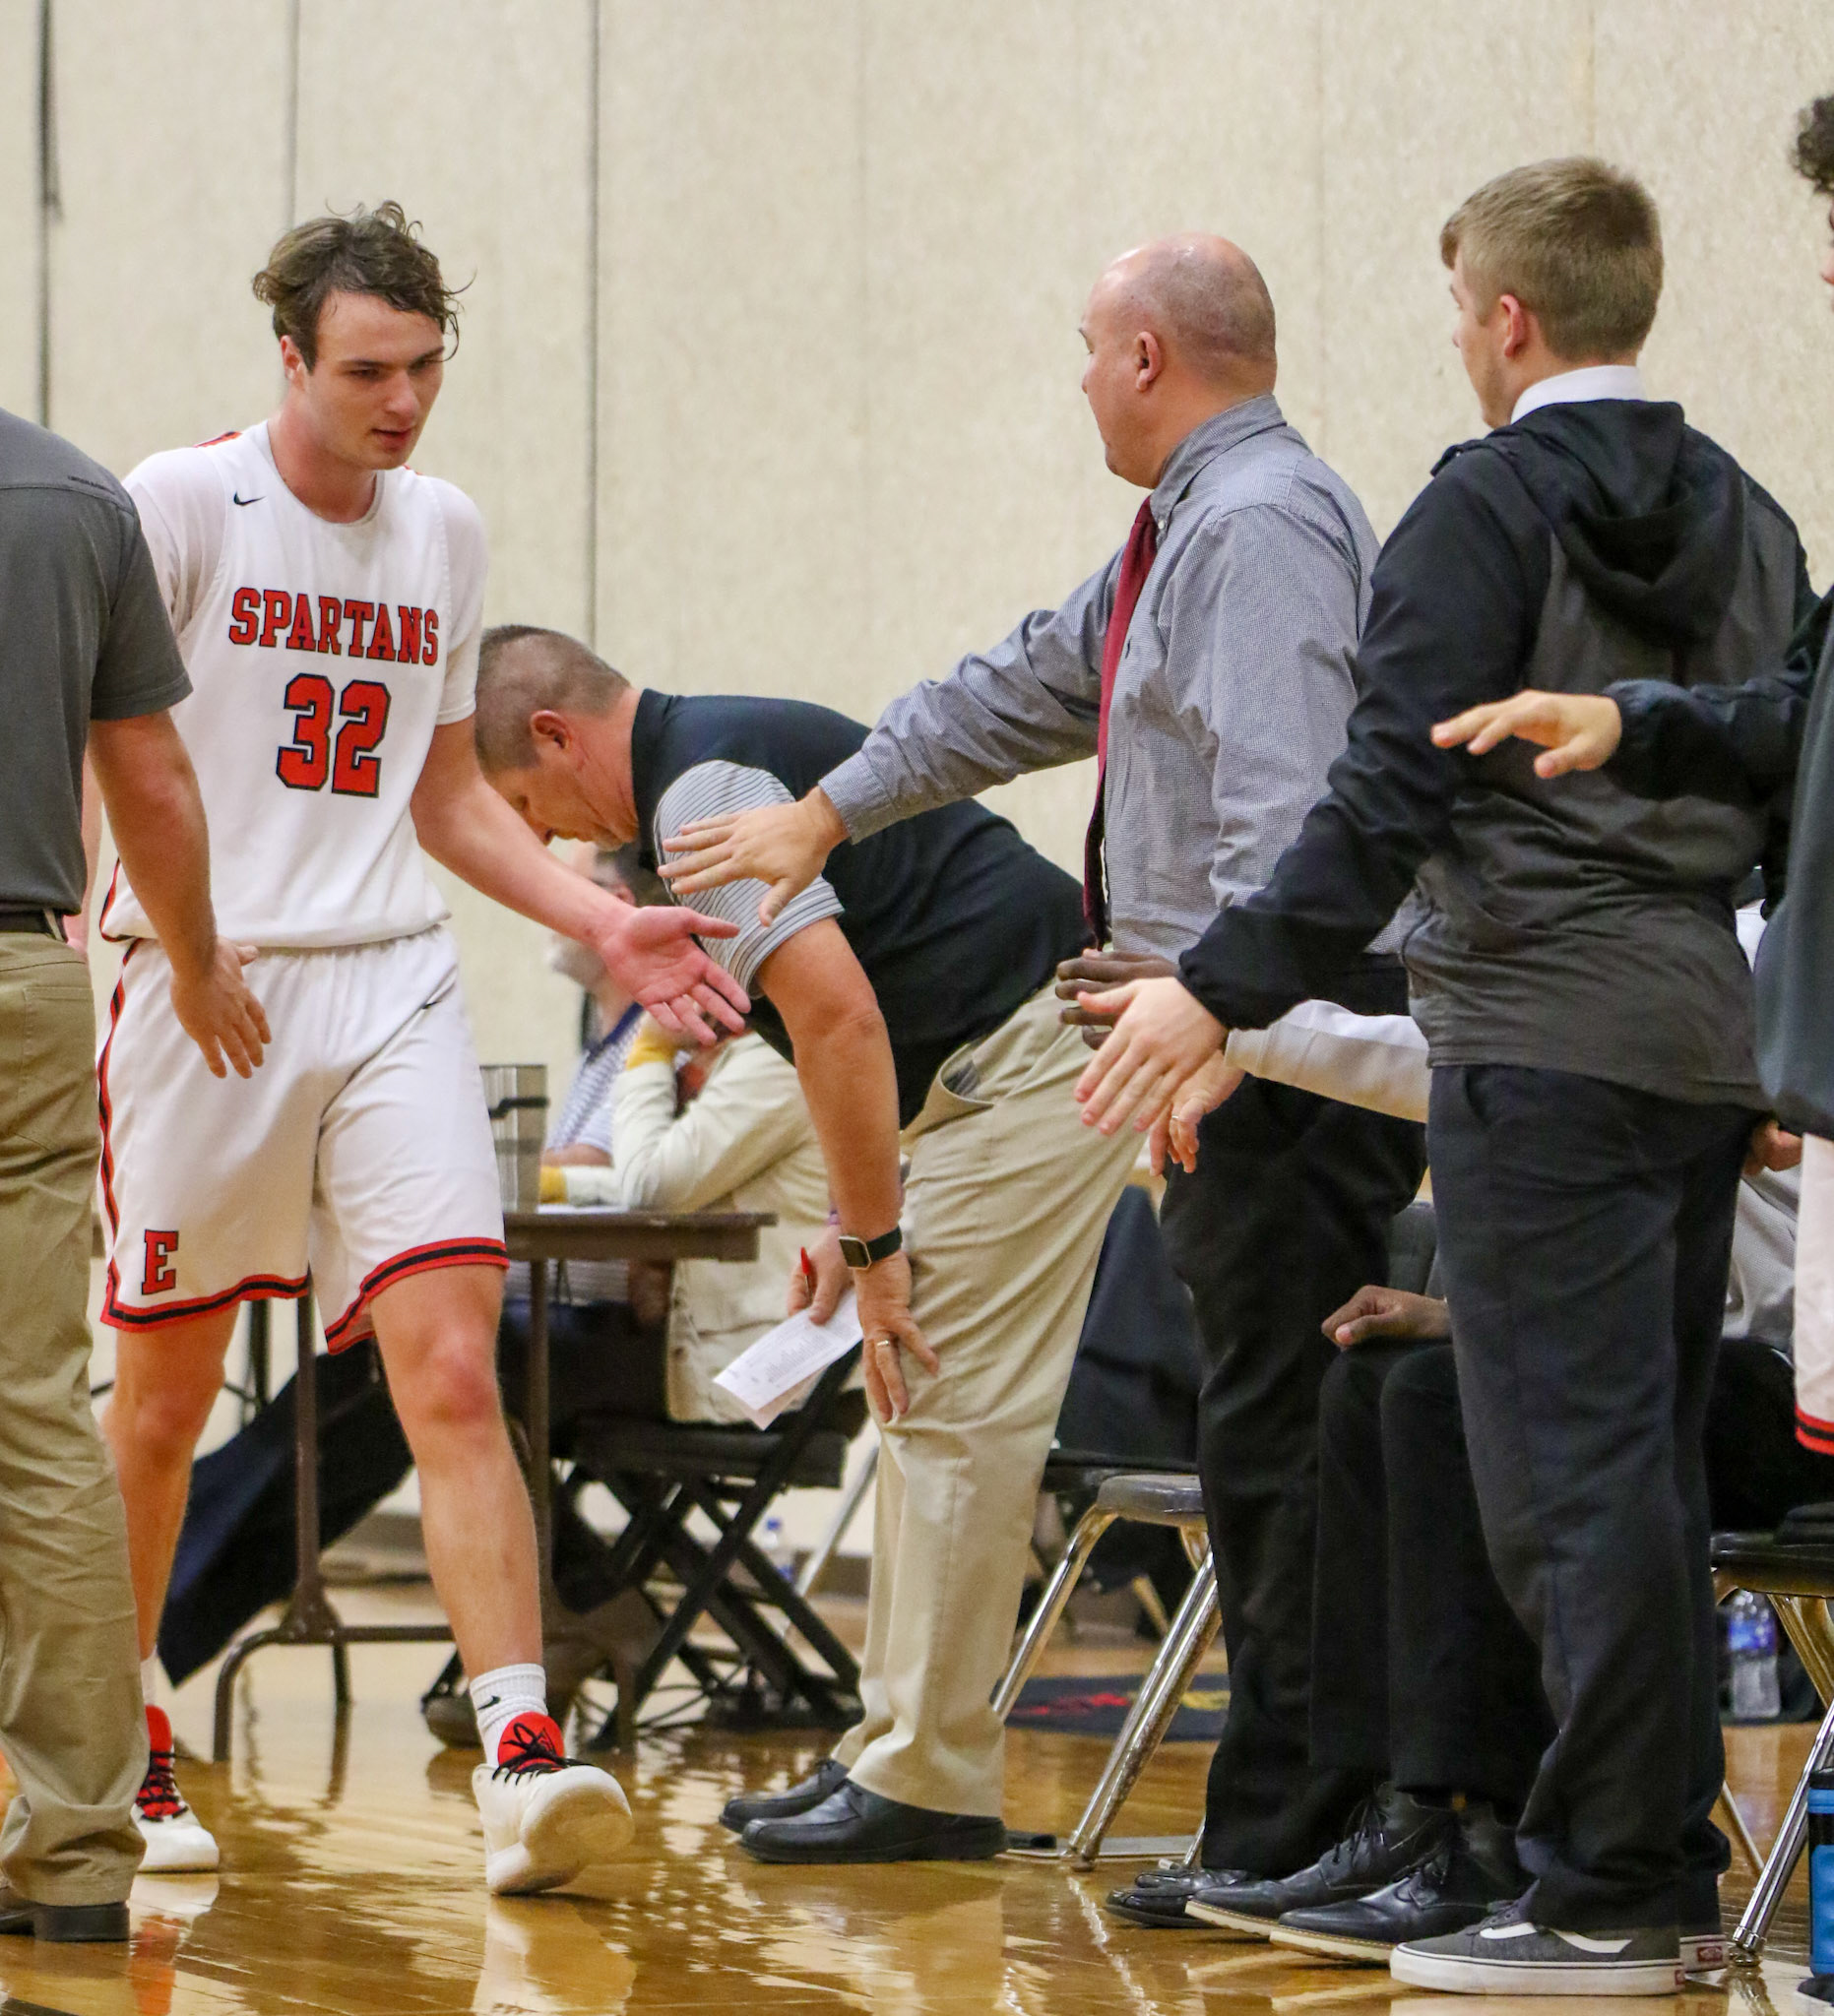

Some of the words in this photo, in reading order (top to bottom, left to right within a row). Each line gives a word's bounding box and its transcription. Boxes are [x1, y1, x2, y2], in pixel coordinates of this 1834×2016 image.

[228, 587, 439, 666] SPARTANS
[276, 672, 392, 798] 32
[141, 1228, 179, 1295] E
